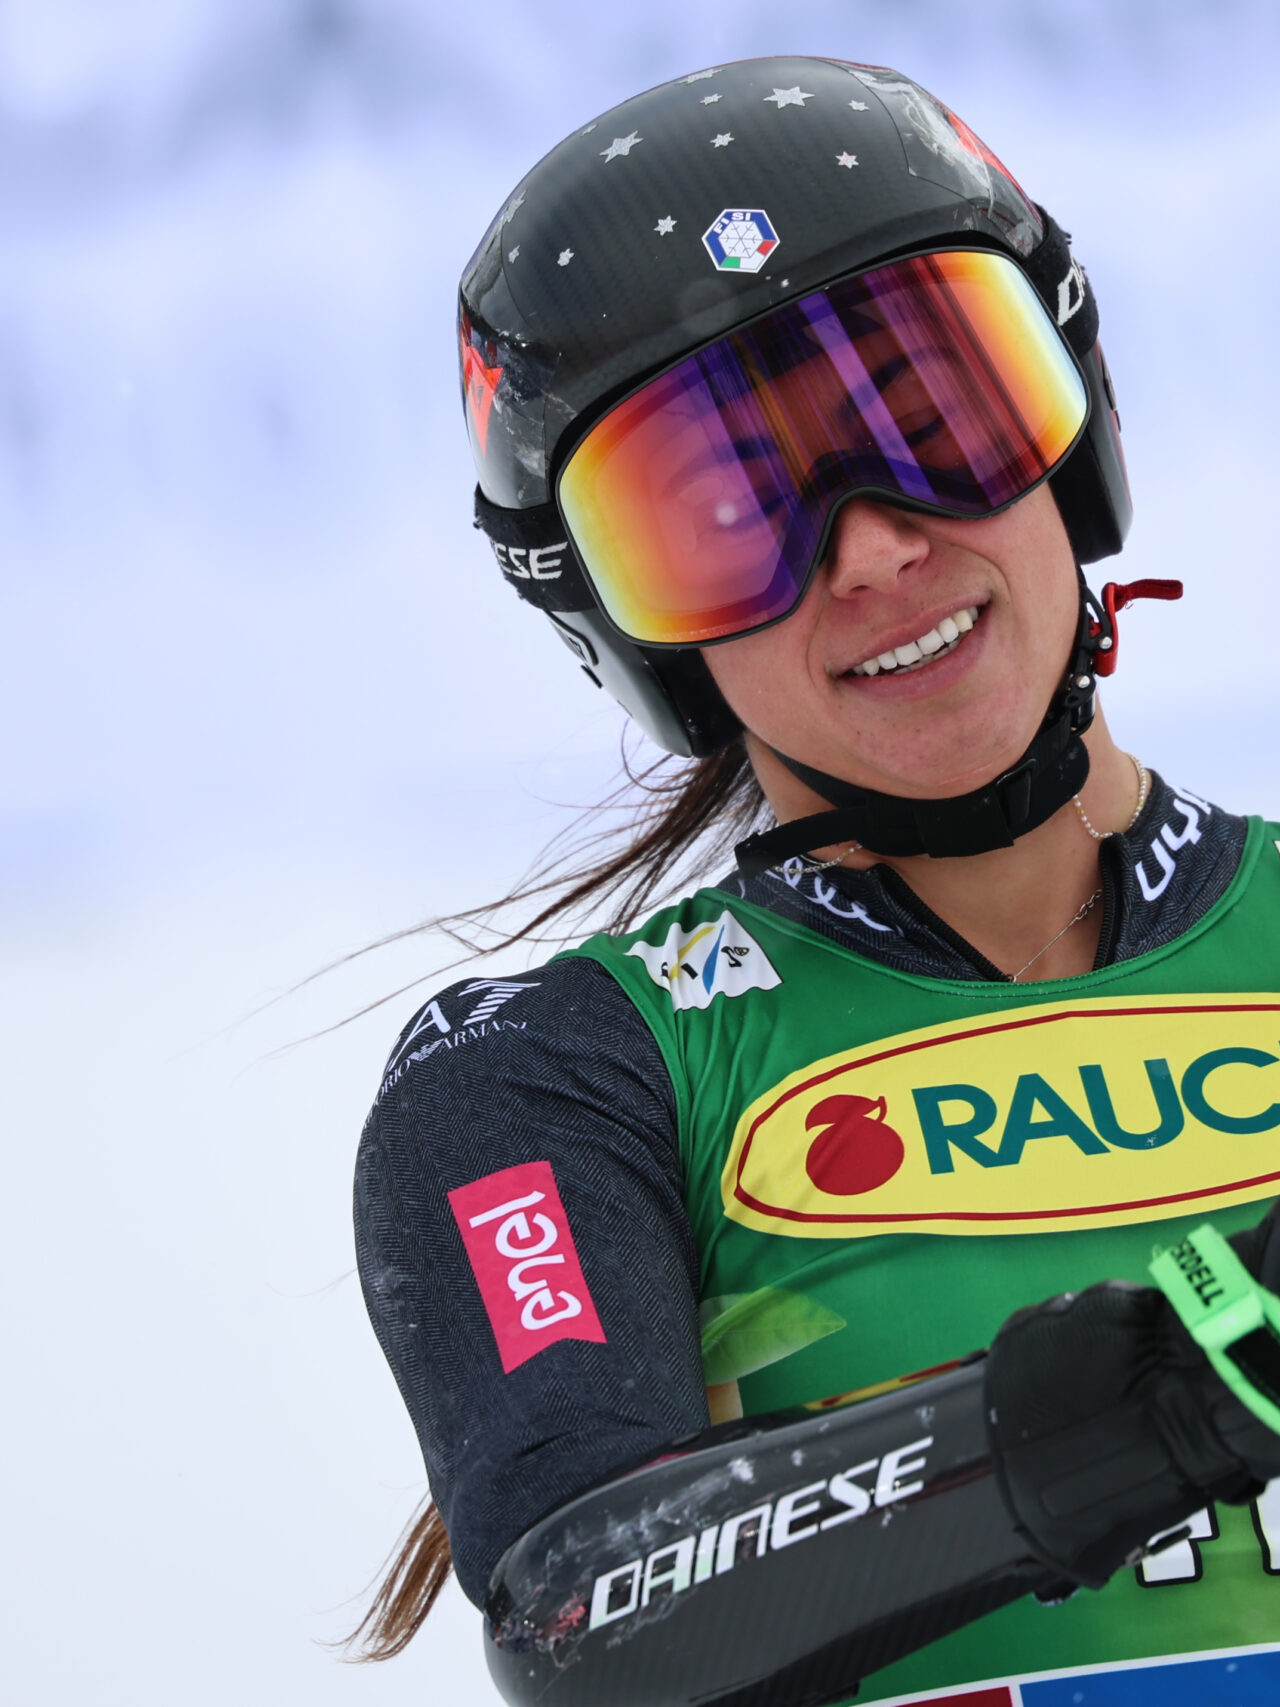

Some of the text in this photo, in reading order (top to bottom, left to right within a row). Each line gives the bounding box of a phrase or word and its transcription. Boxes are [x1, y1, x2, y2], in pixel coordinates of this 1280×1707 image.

[713, 212, 752, 235] FISI
[438, 1020, 528, 1054] ARMANI
[468, 1190, 583, 1331] enel
[589, 1435, 933, 1631] DAINESE
